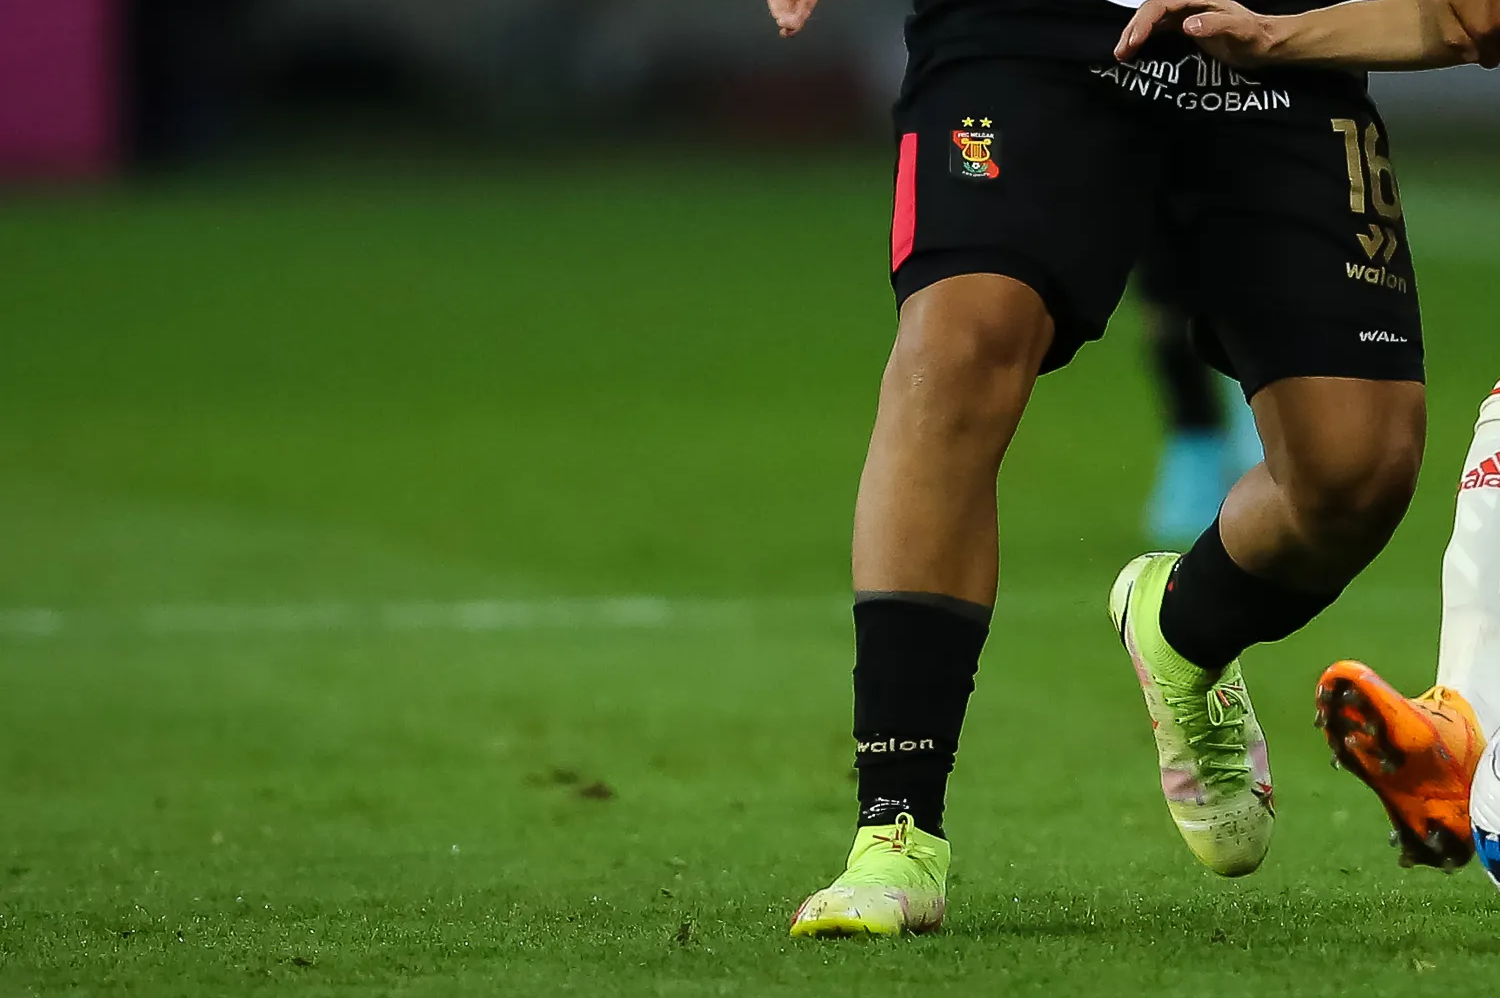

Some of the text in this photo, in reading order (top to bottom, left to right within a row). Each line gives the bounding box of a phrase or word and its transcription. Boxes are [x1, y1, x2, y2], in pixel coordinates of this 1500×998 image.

[1089, 66, 1291, 112] AINT-GOBAIN
[1330, 118, 1402, 219] 16
[1346, 262, 1407, 294] walon
[857, 738, 934, 753] walon
